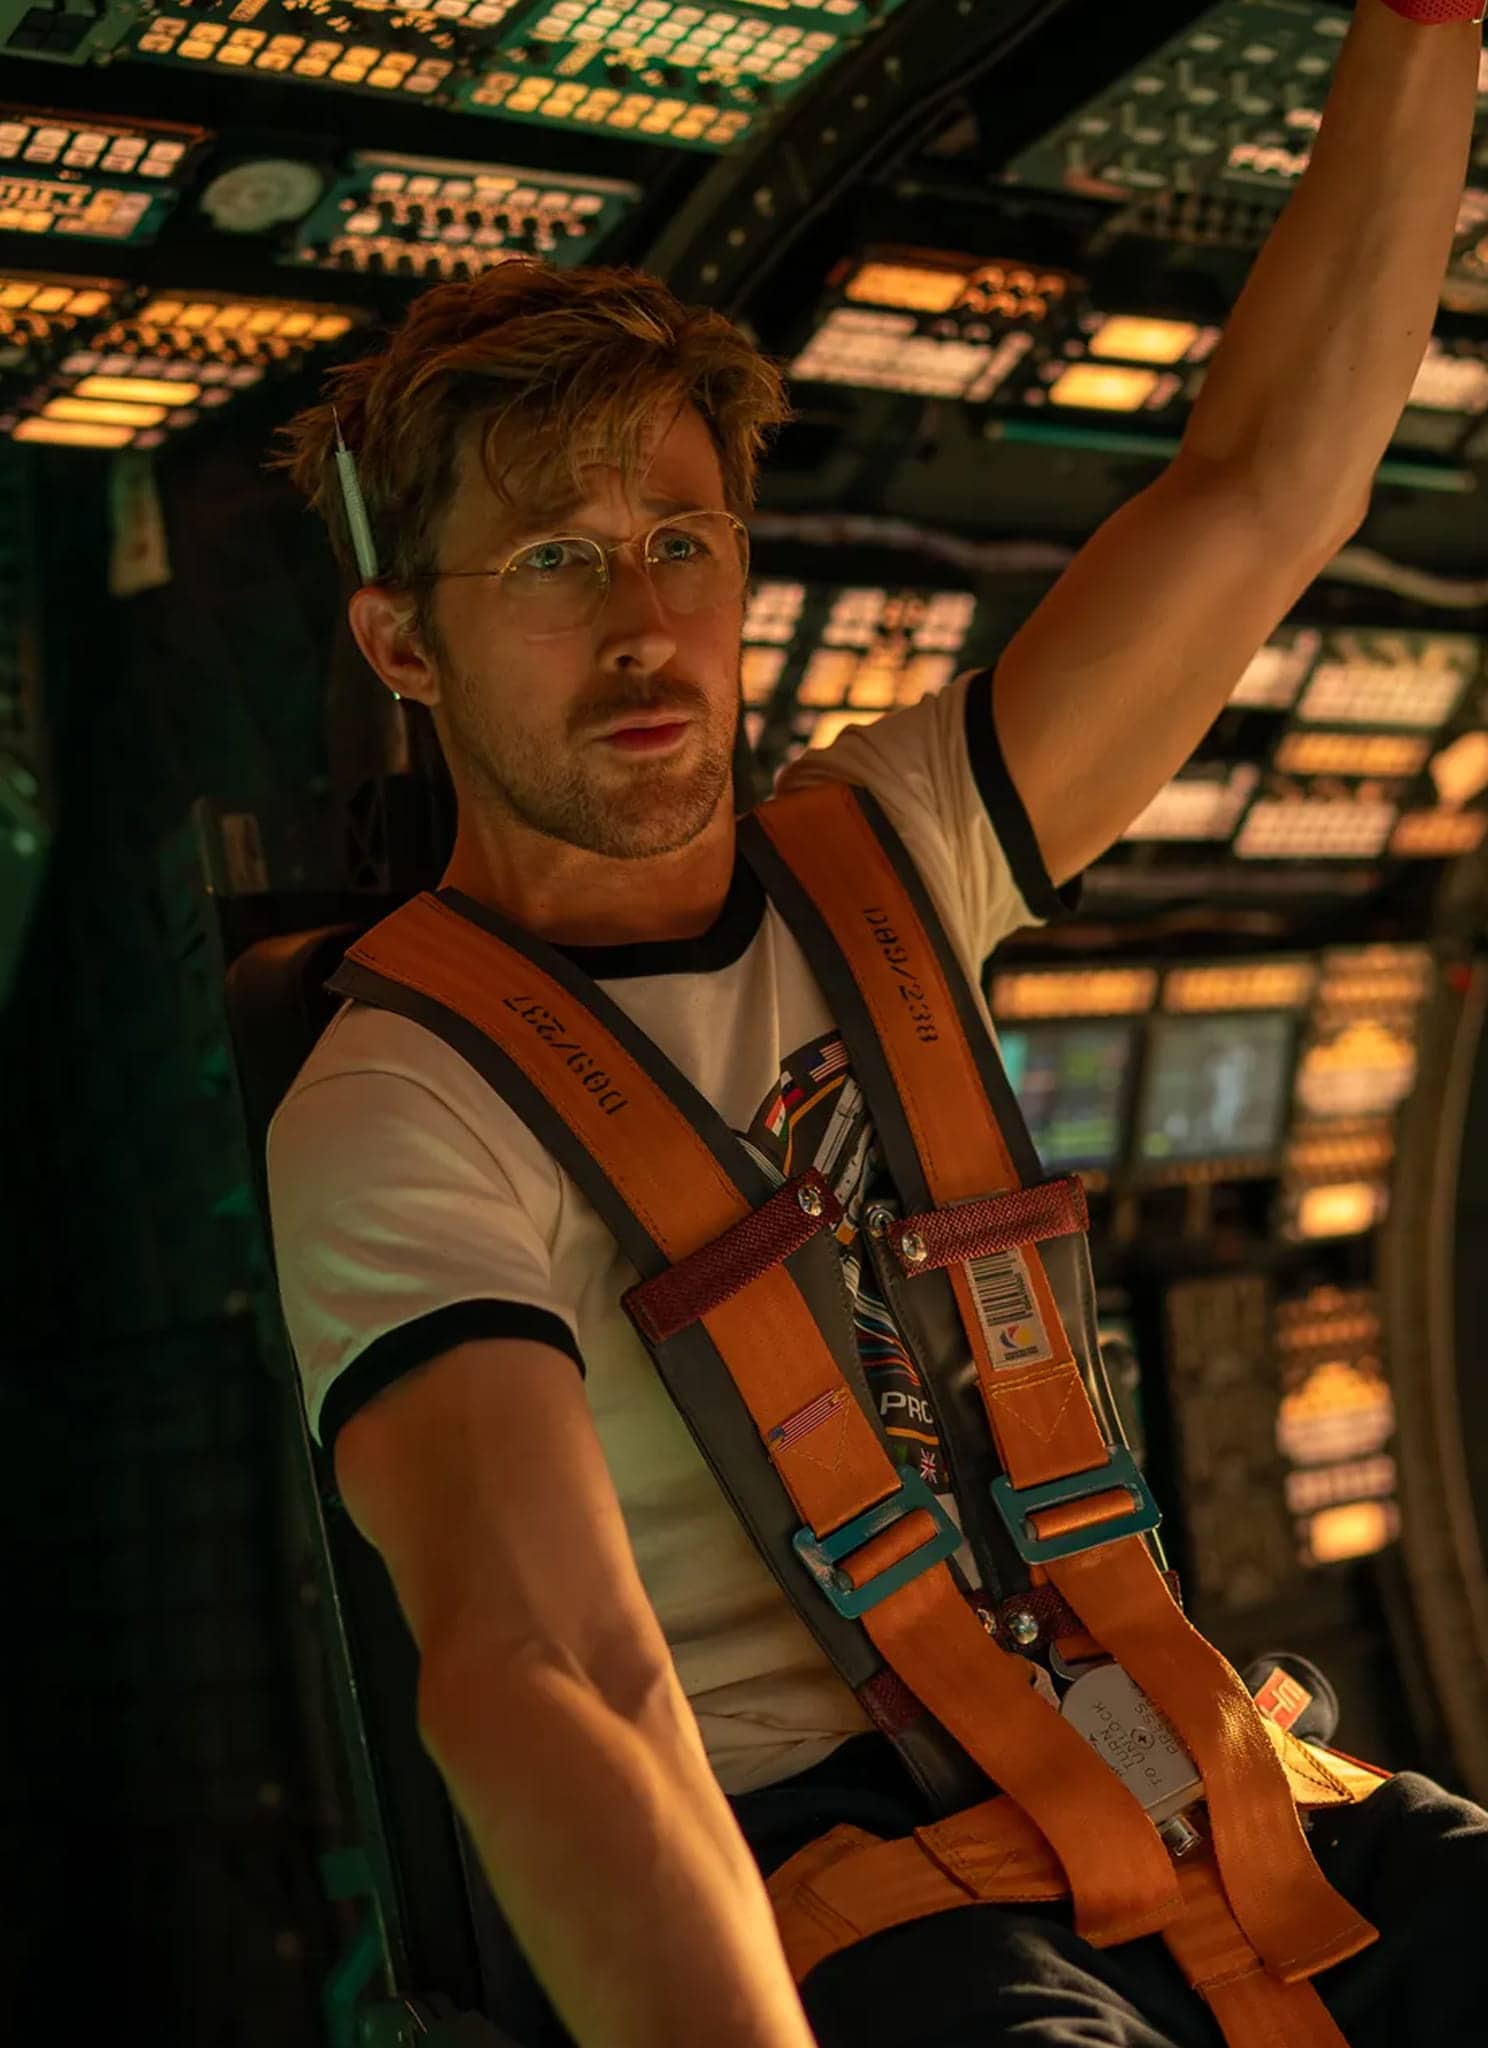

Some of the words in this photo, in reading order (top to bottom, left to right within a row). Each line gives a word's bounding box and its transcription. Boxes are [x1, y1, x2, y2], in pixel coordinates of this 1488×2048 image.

[502, 996, 629, 1115] D09/237
[1093, 1701, 1146, 1764] UNLOCK
[1100, 1729, 1136, 1769] TURN
[1134, 1702, 1179, 1754] PRESS
[1144, 1767, 1163, 1786] TO
